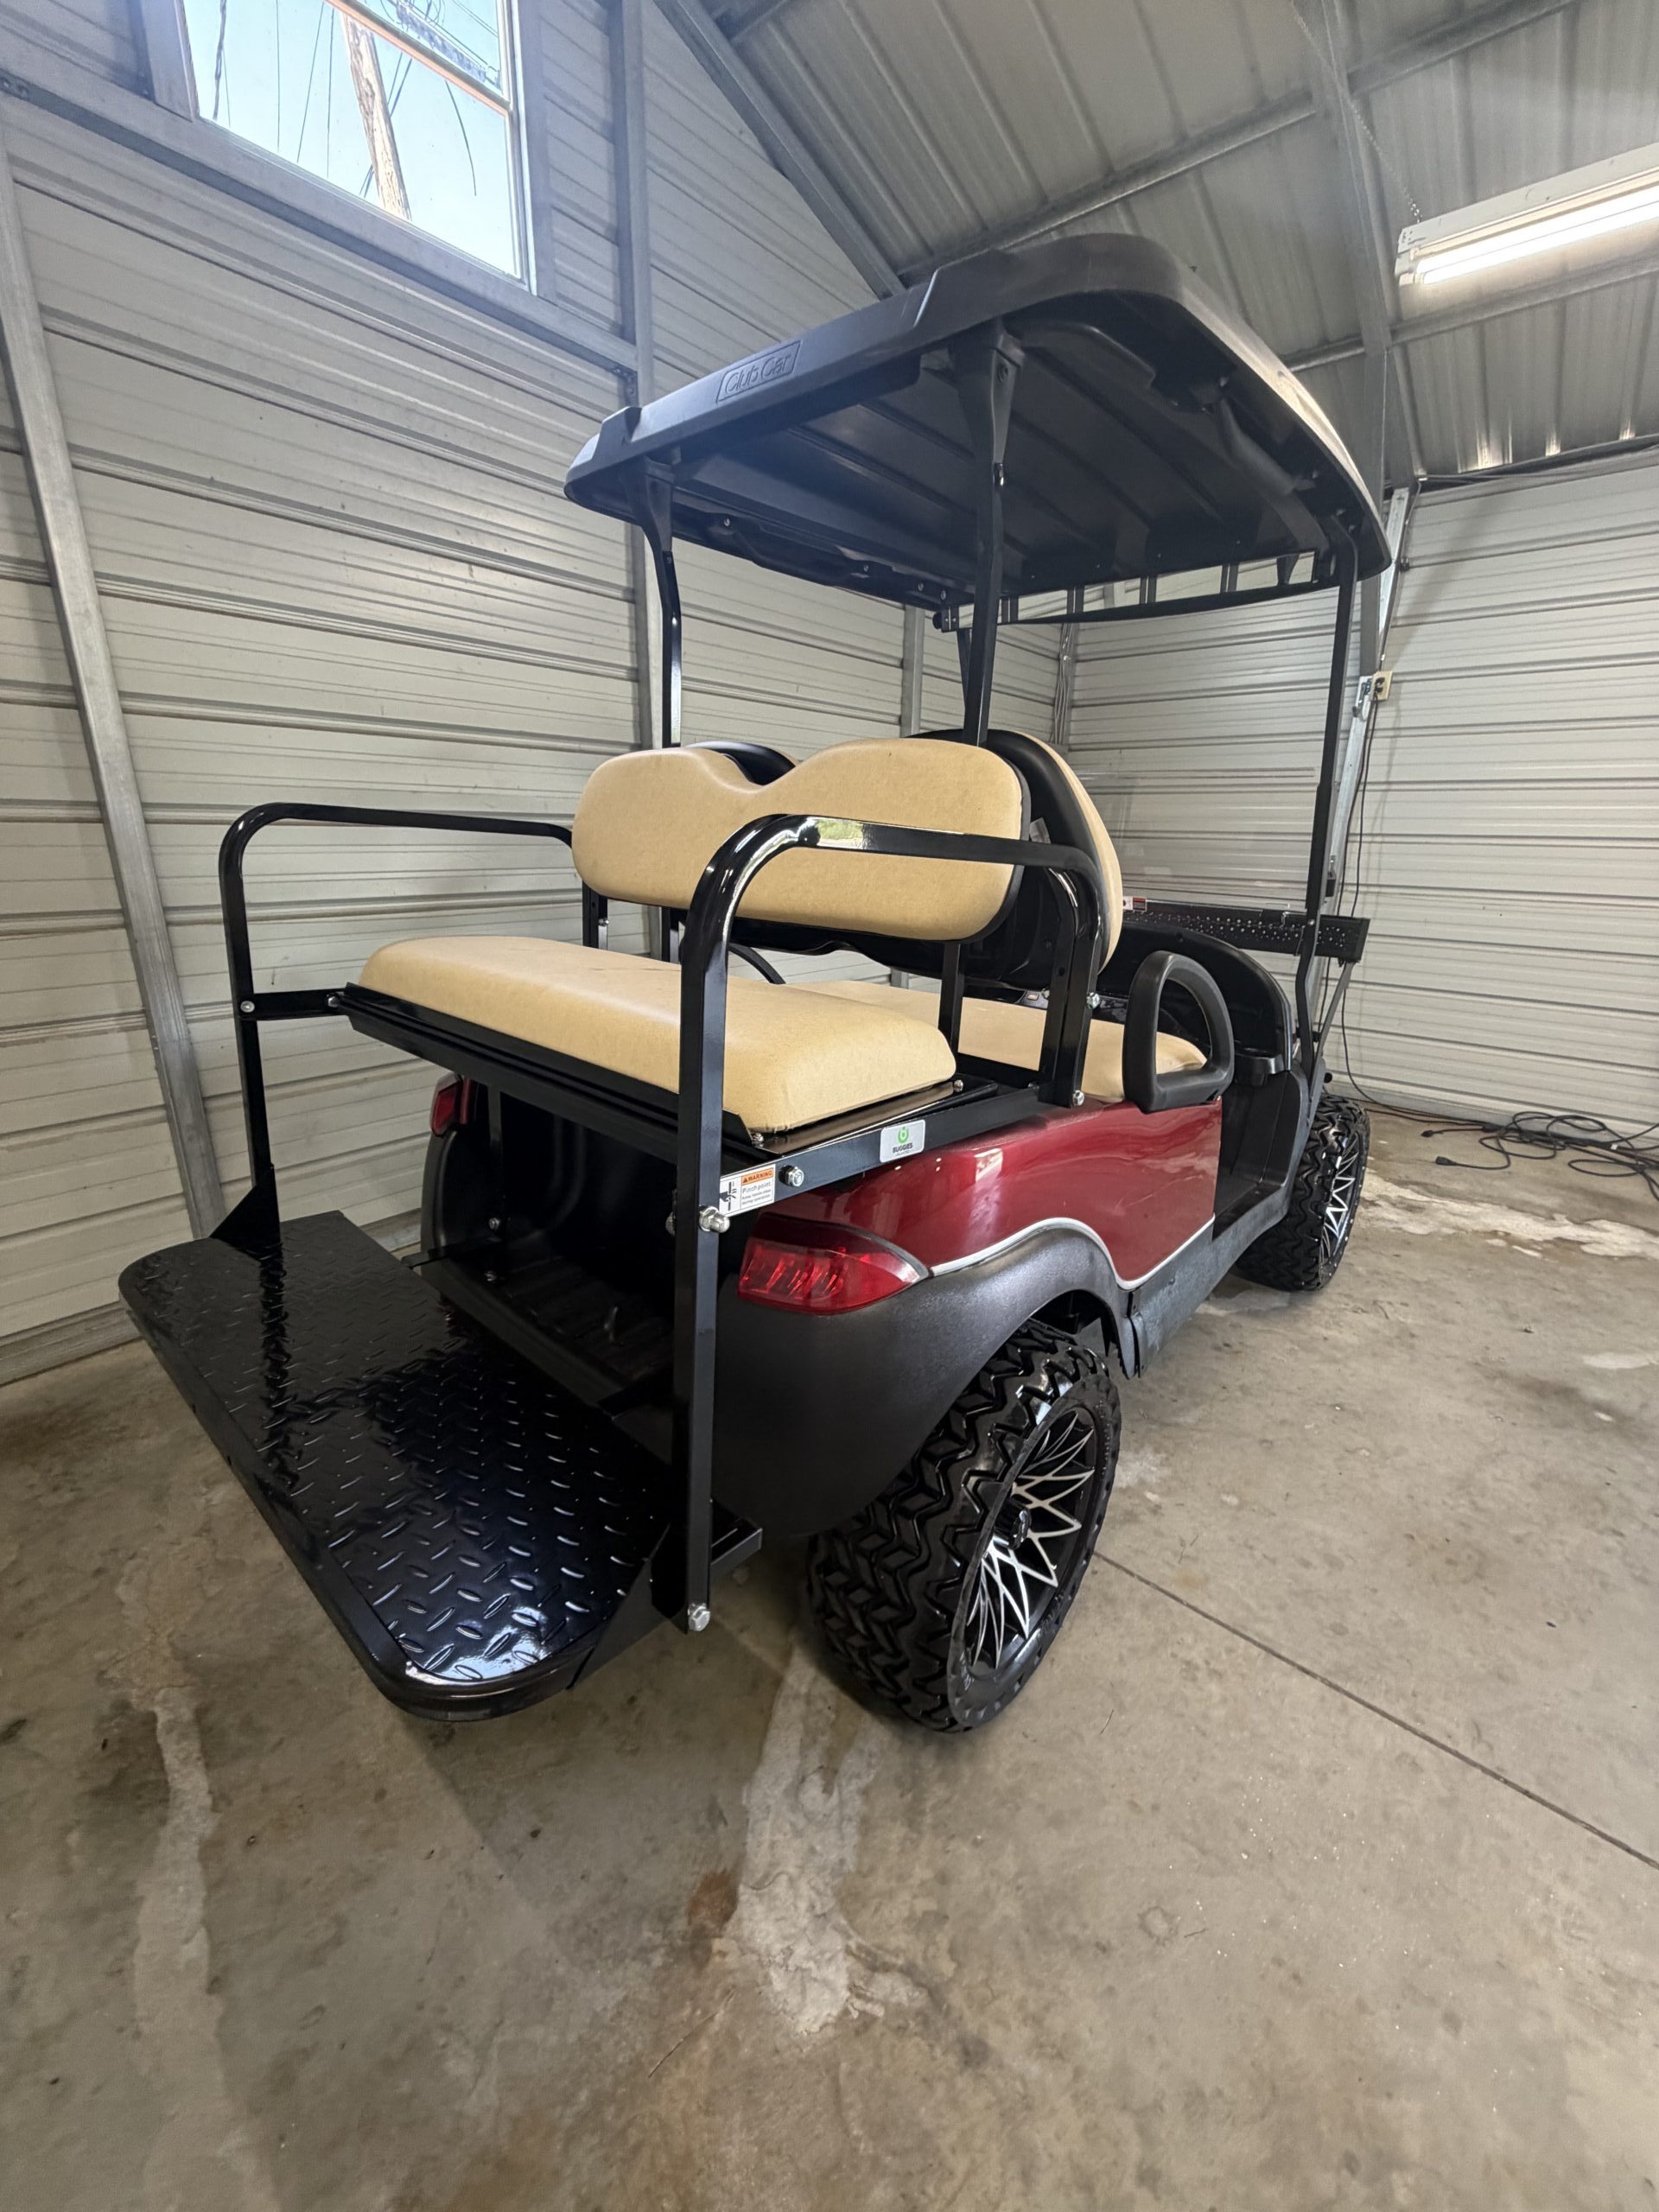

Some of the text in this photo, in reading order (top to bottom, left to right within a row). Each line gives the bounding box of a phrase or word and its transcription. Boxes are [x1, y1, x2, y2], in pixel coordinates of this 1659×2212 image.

[725, 354, 791, 394] Club Car
[892, 1142, 913, 1154] BUGGIES
[747, 1170, 772, 1181] WARNING
